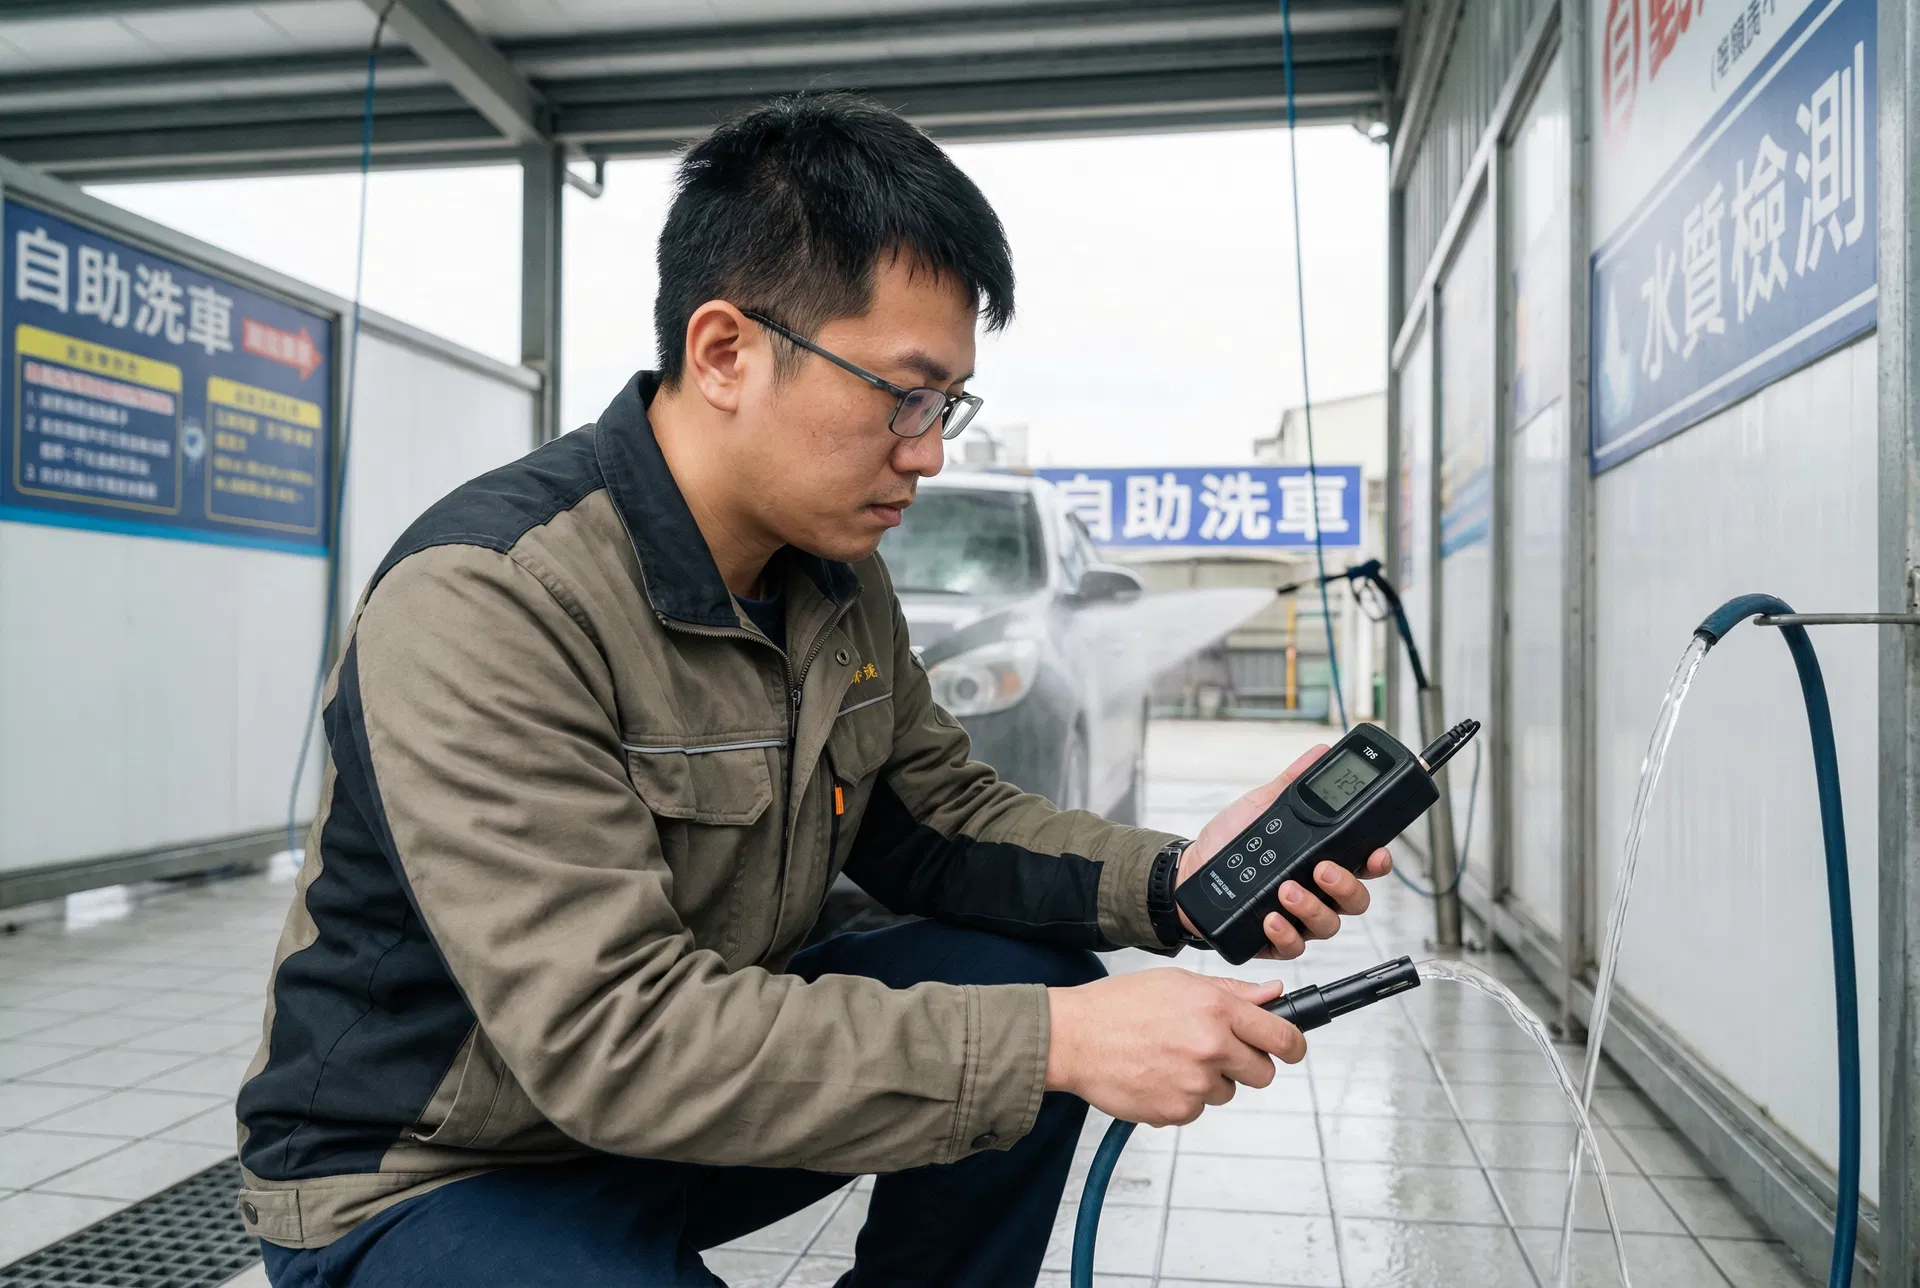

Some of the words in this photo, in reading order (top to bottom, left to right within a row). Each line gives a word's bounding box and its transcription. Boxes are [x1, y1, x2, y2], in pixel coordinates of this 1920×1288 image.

[1640, 40, 1865, 382] 水質檢測
[15, 227, 235, 356] 自助洗車
[1054, 470, 1350, 542] 自助洗車
[1362, 746, 1379, 760] TDS
